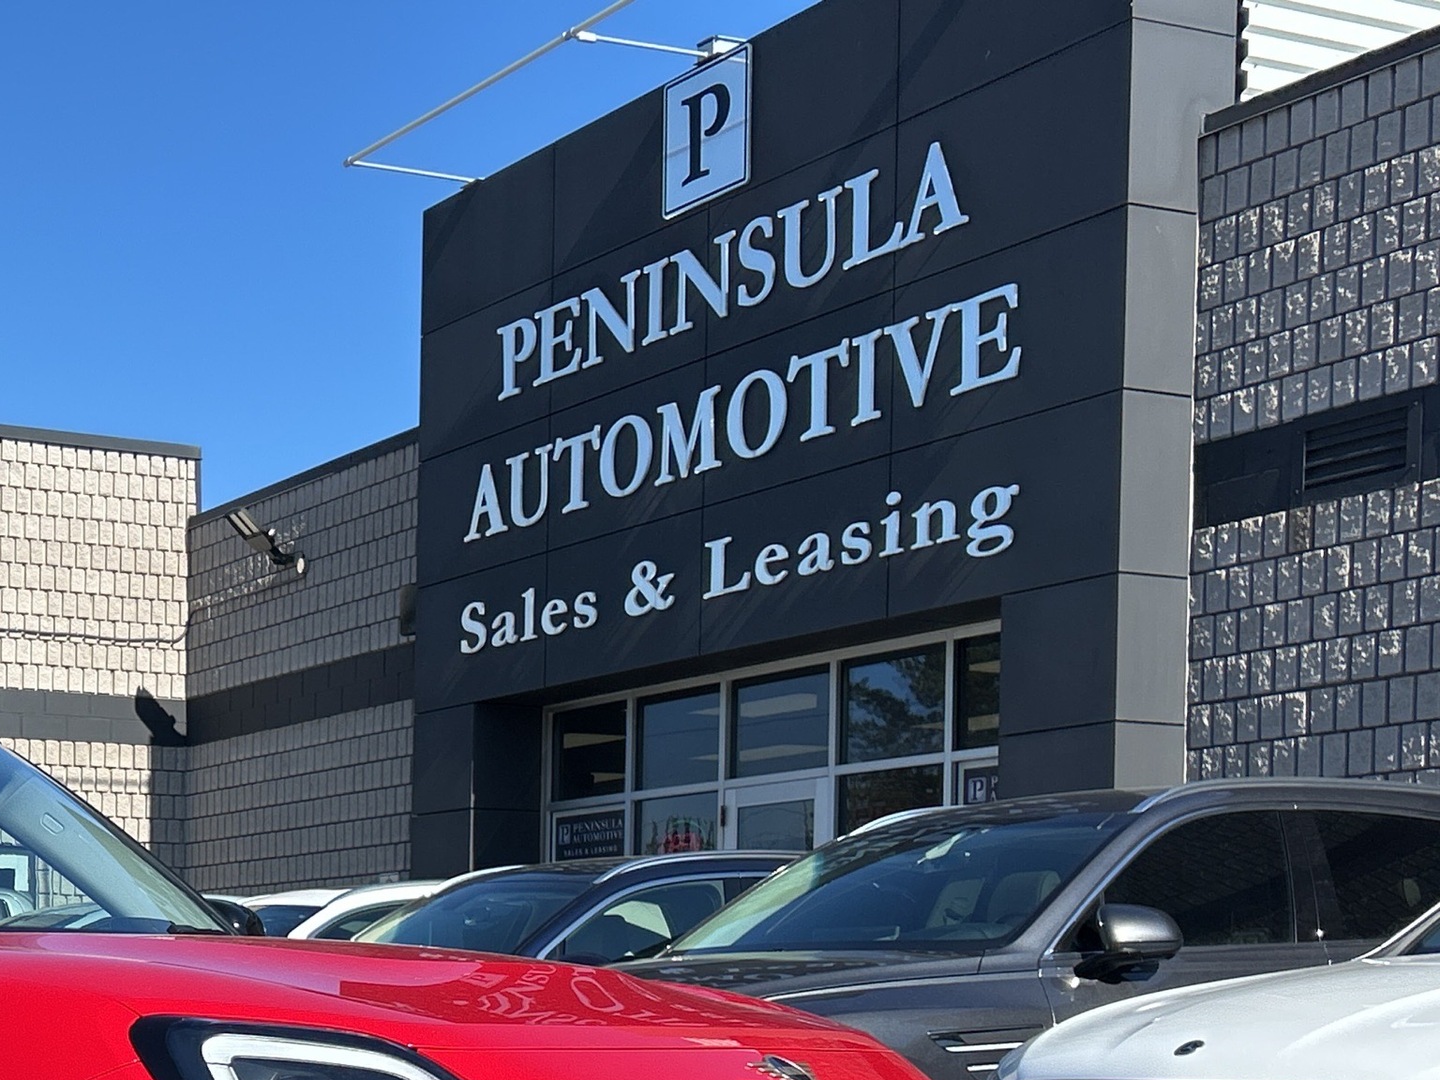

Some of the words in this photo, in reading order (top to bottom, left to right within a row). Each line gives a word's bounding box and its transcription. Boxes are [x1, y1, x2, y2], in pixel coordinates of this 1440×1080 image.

[681, 82, 731, 188] P
[497, 141, 969, 401] PENINSULA
[464, 283, 1021, 542] AUTOMOTIVE
[460, 587, 598, 655] Sales
[624, 560, 675, 617] &
[703, 484, 1020, 600] Leasing
[573, 819, 623, 833] PENINSULA
[573, 830, 623, 843] AUTOMOTIVE
[971, 779, 984, 800] P
